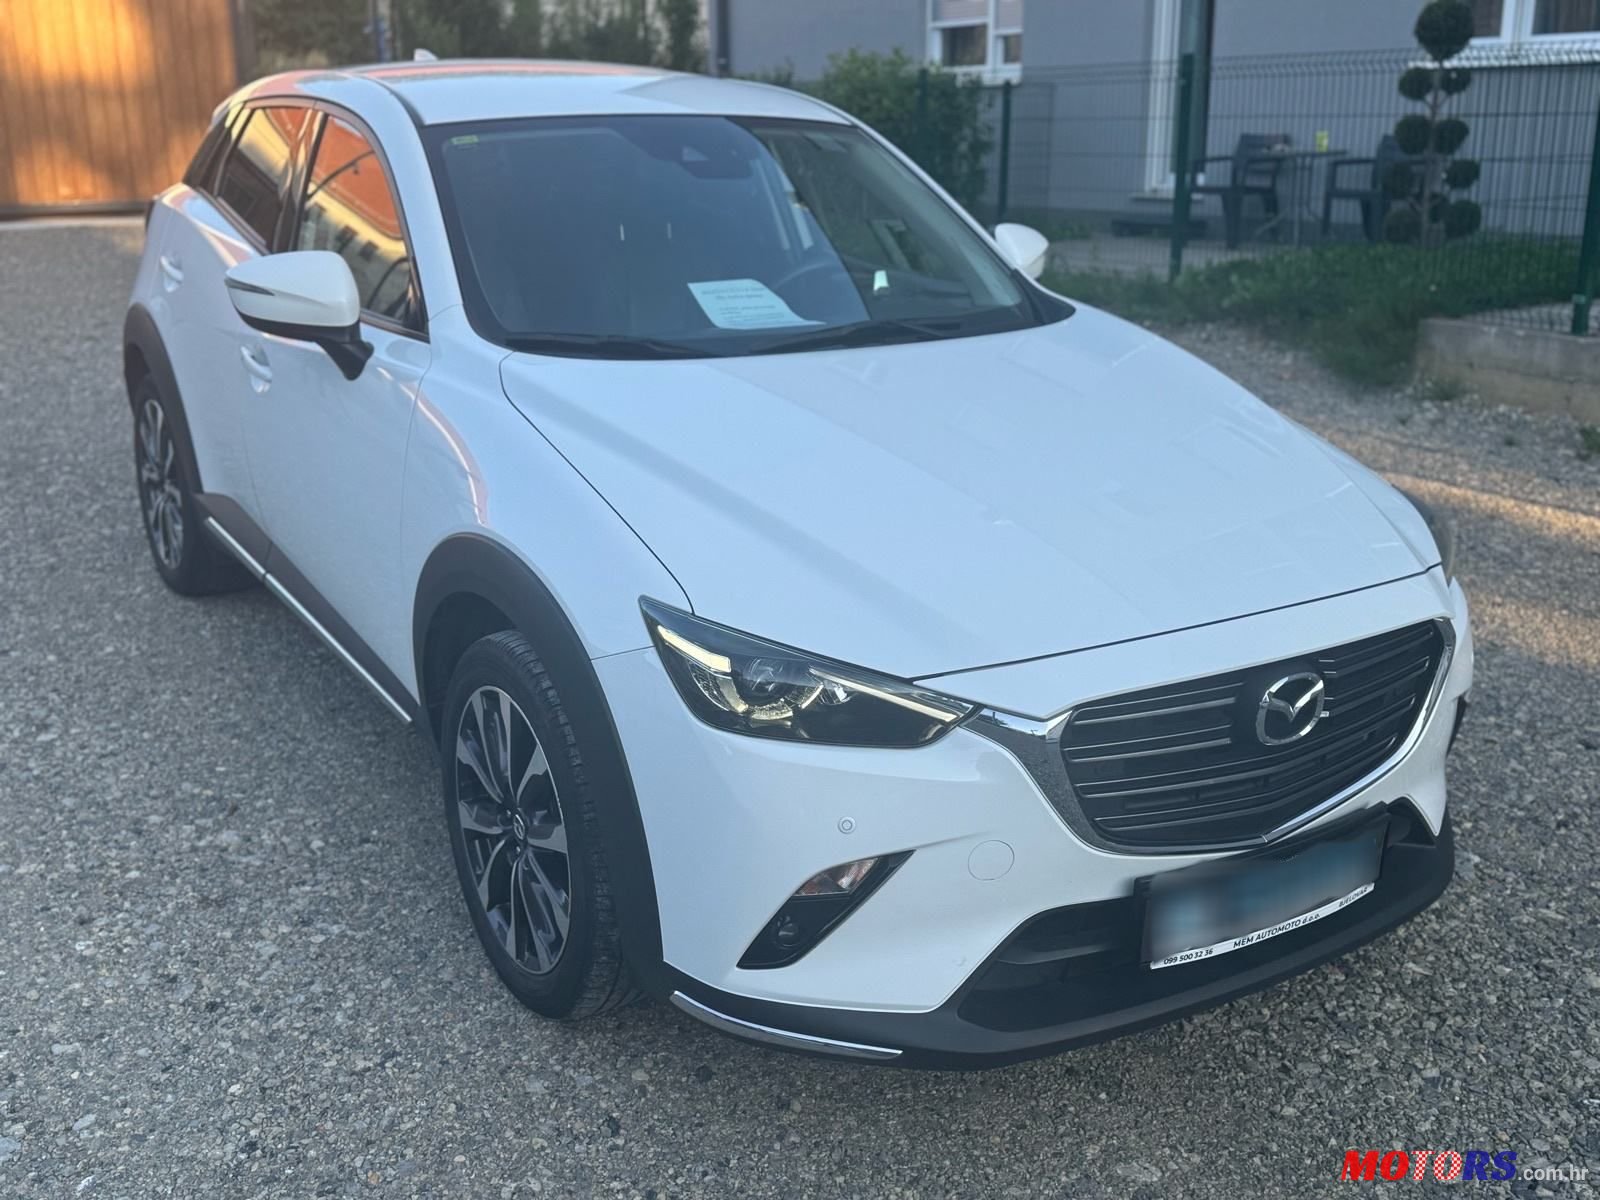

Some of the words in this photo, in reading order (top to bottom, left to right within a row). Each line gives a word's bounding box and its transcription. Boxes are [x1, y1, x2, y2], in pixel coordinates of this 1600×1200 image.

[1163, 956, 1178, 965] 099
[1179, 953, 1193, 962] 500
[1194, 950, 1203, 960] 32
[1204, 948, 1214, 956] 36
[1233, 935, 1254, 948] MEM
[1255, 919, 1301, 941] AUTOMOTO
[1302, 913, 1321, 924] d.o.o.
[1338, 886, 1368, 907] BJELOVAR
